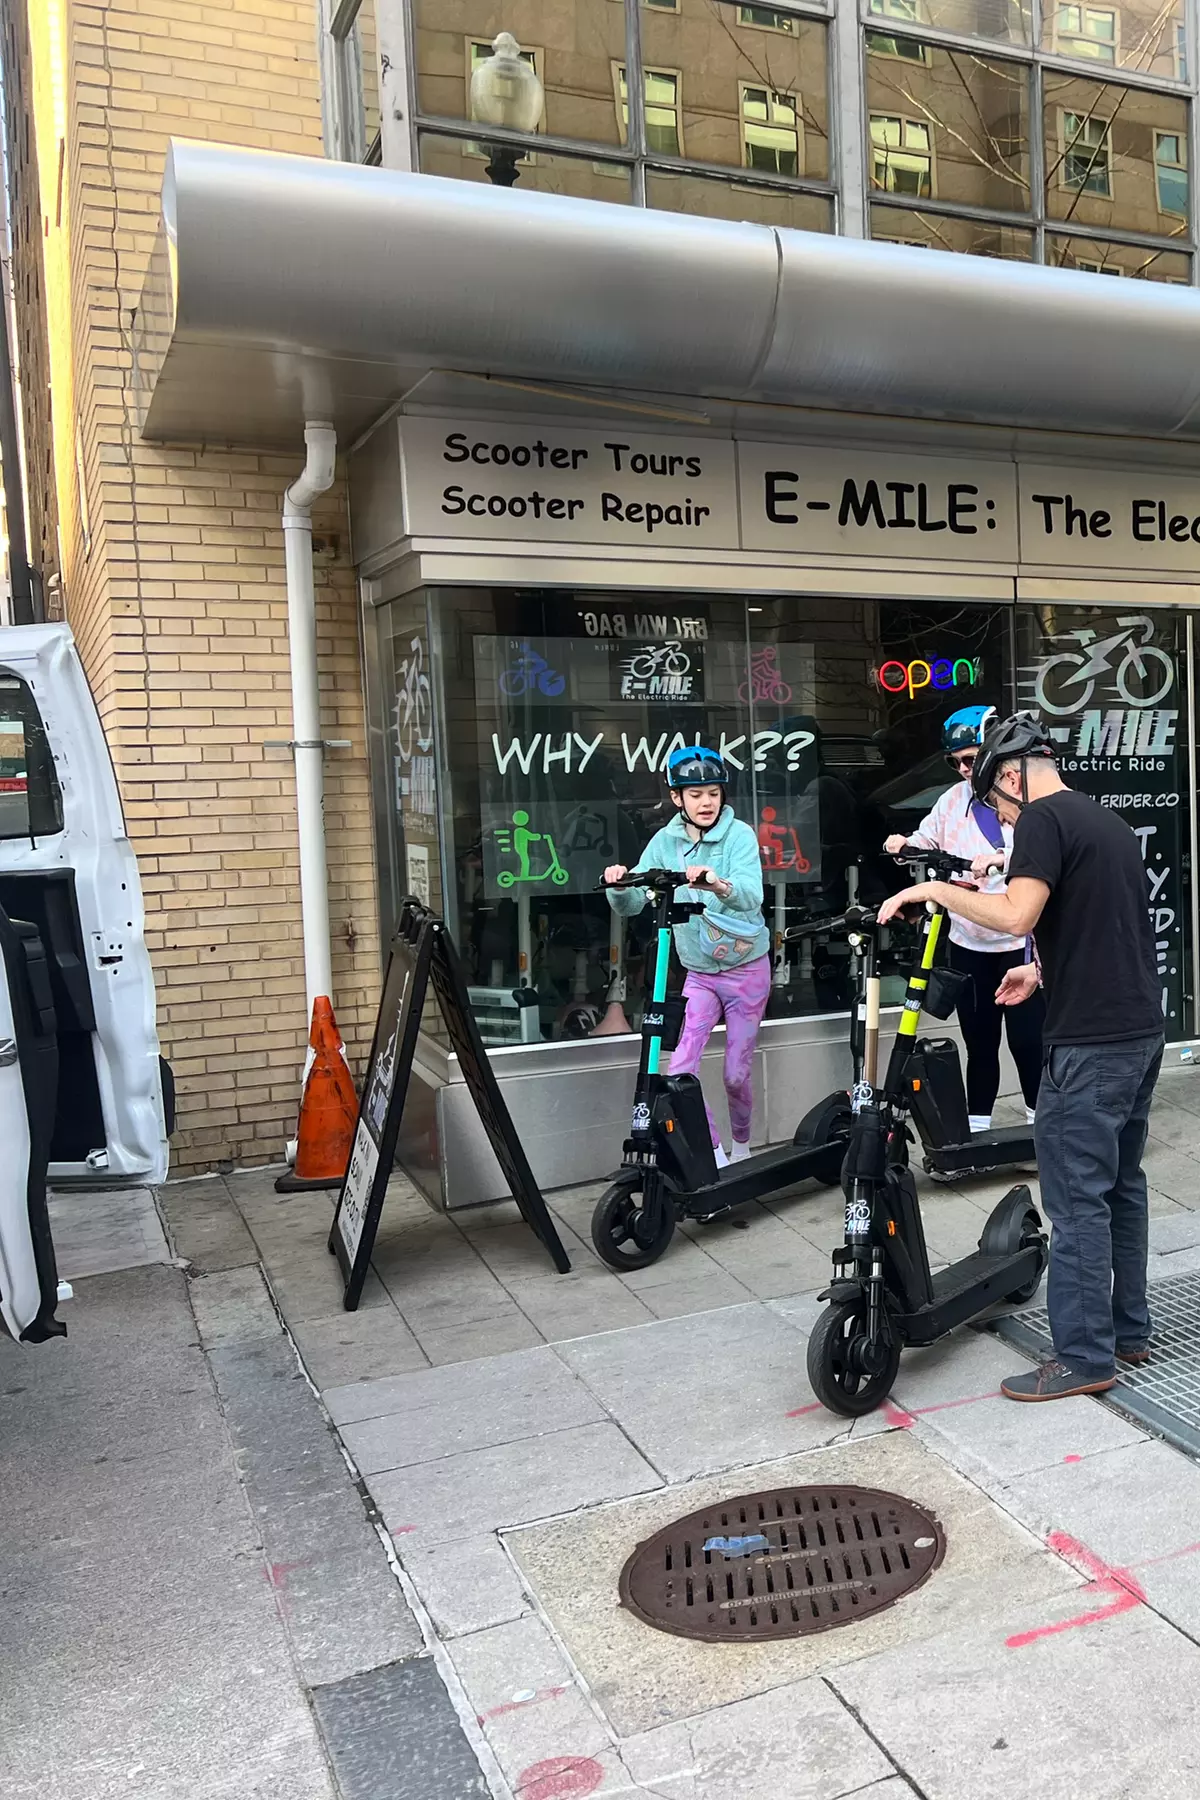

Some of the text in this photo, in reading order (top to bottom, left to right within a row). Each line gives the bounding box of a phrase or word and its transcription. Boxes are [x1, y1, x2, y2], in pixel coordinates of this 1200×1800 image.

[443, 433, 701, 478] Scooter Tours
[441, 486, 710, 533] Scooter Repair
[765, 471, 996, 534] E-MILE:
[1031, 494, 1112, 538] The
[620, 675, 694, 695] E-MILE
[879, 658, 975, 700] open
[491, 731, 604, 775] WHY
[1028, 709, 1179, 757] -MILE
[1128, 757, 1166, 772] Ride
